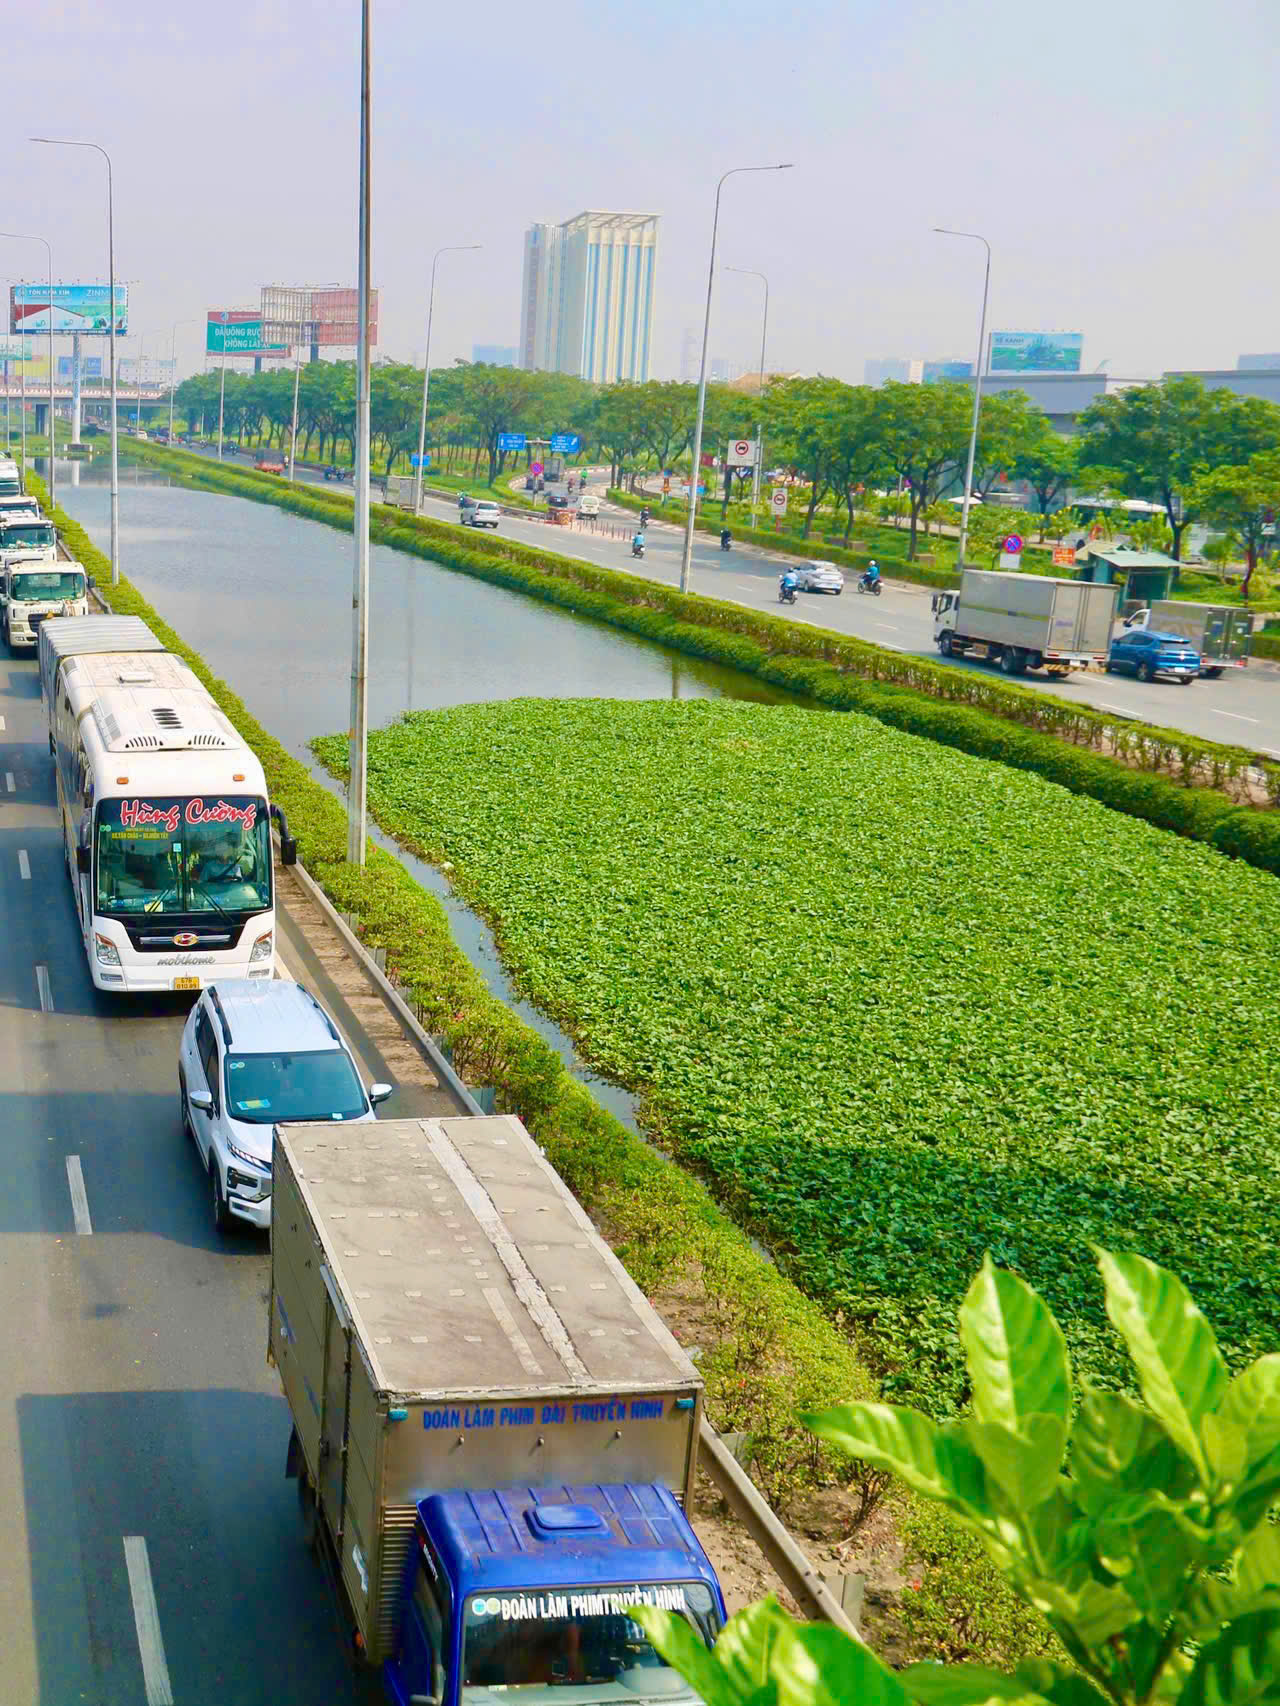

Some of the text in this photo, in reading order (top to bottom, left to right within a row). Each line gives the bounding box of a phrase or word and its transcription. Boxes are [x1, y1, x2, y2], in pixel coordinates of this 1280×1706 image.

[120, 798, 257, 832] Hùng Cường
[463, 1403, 495, 1428] LÀM
[500, 1407, 534, 1425] PHIM
[501, 1593, 538, 1620] ĐOÀN
[540, 1592, 568, 1618] LÀM
